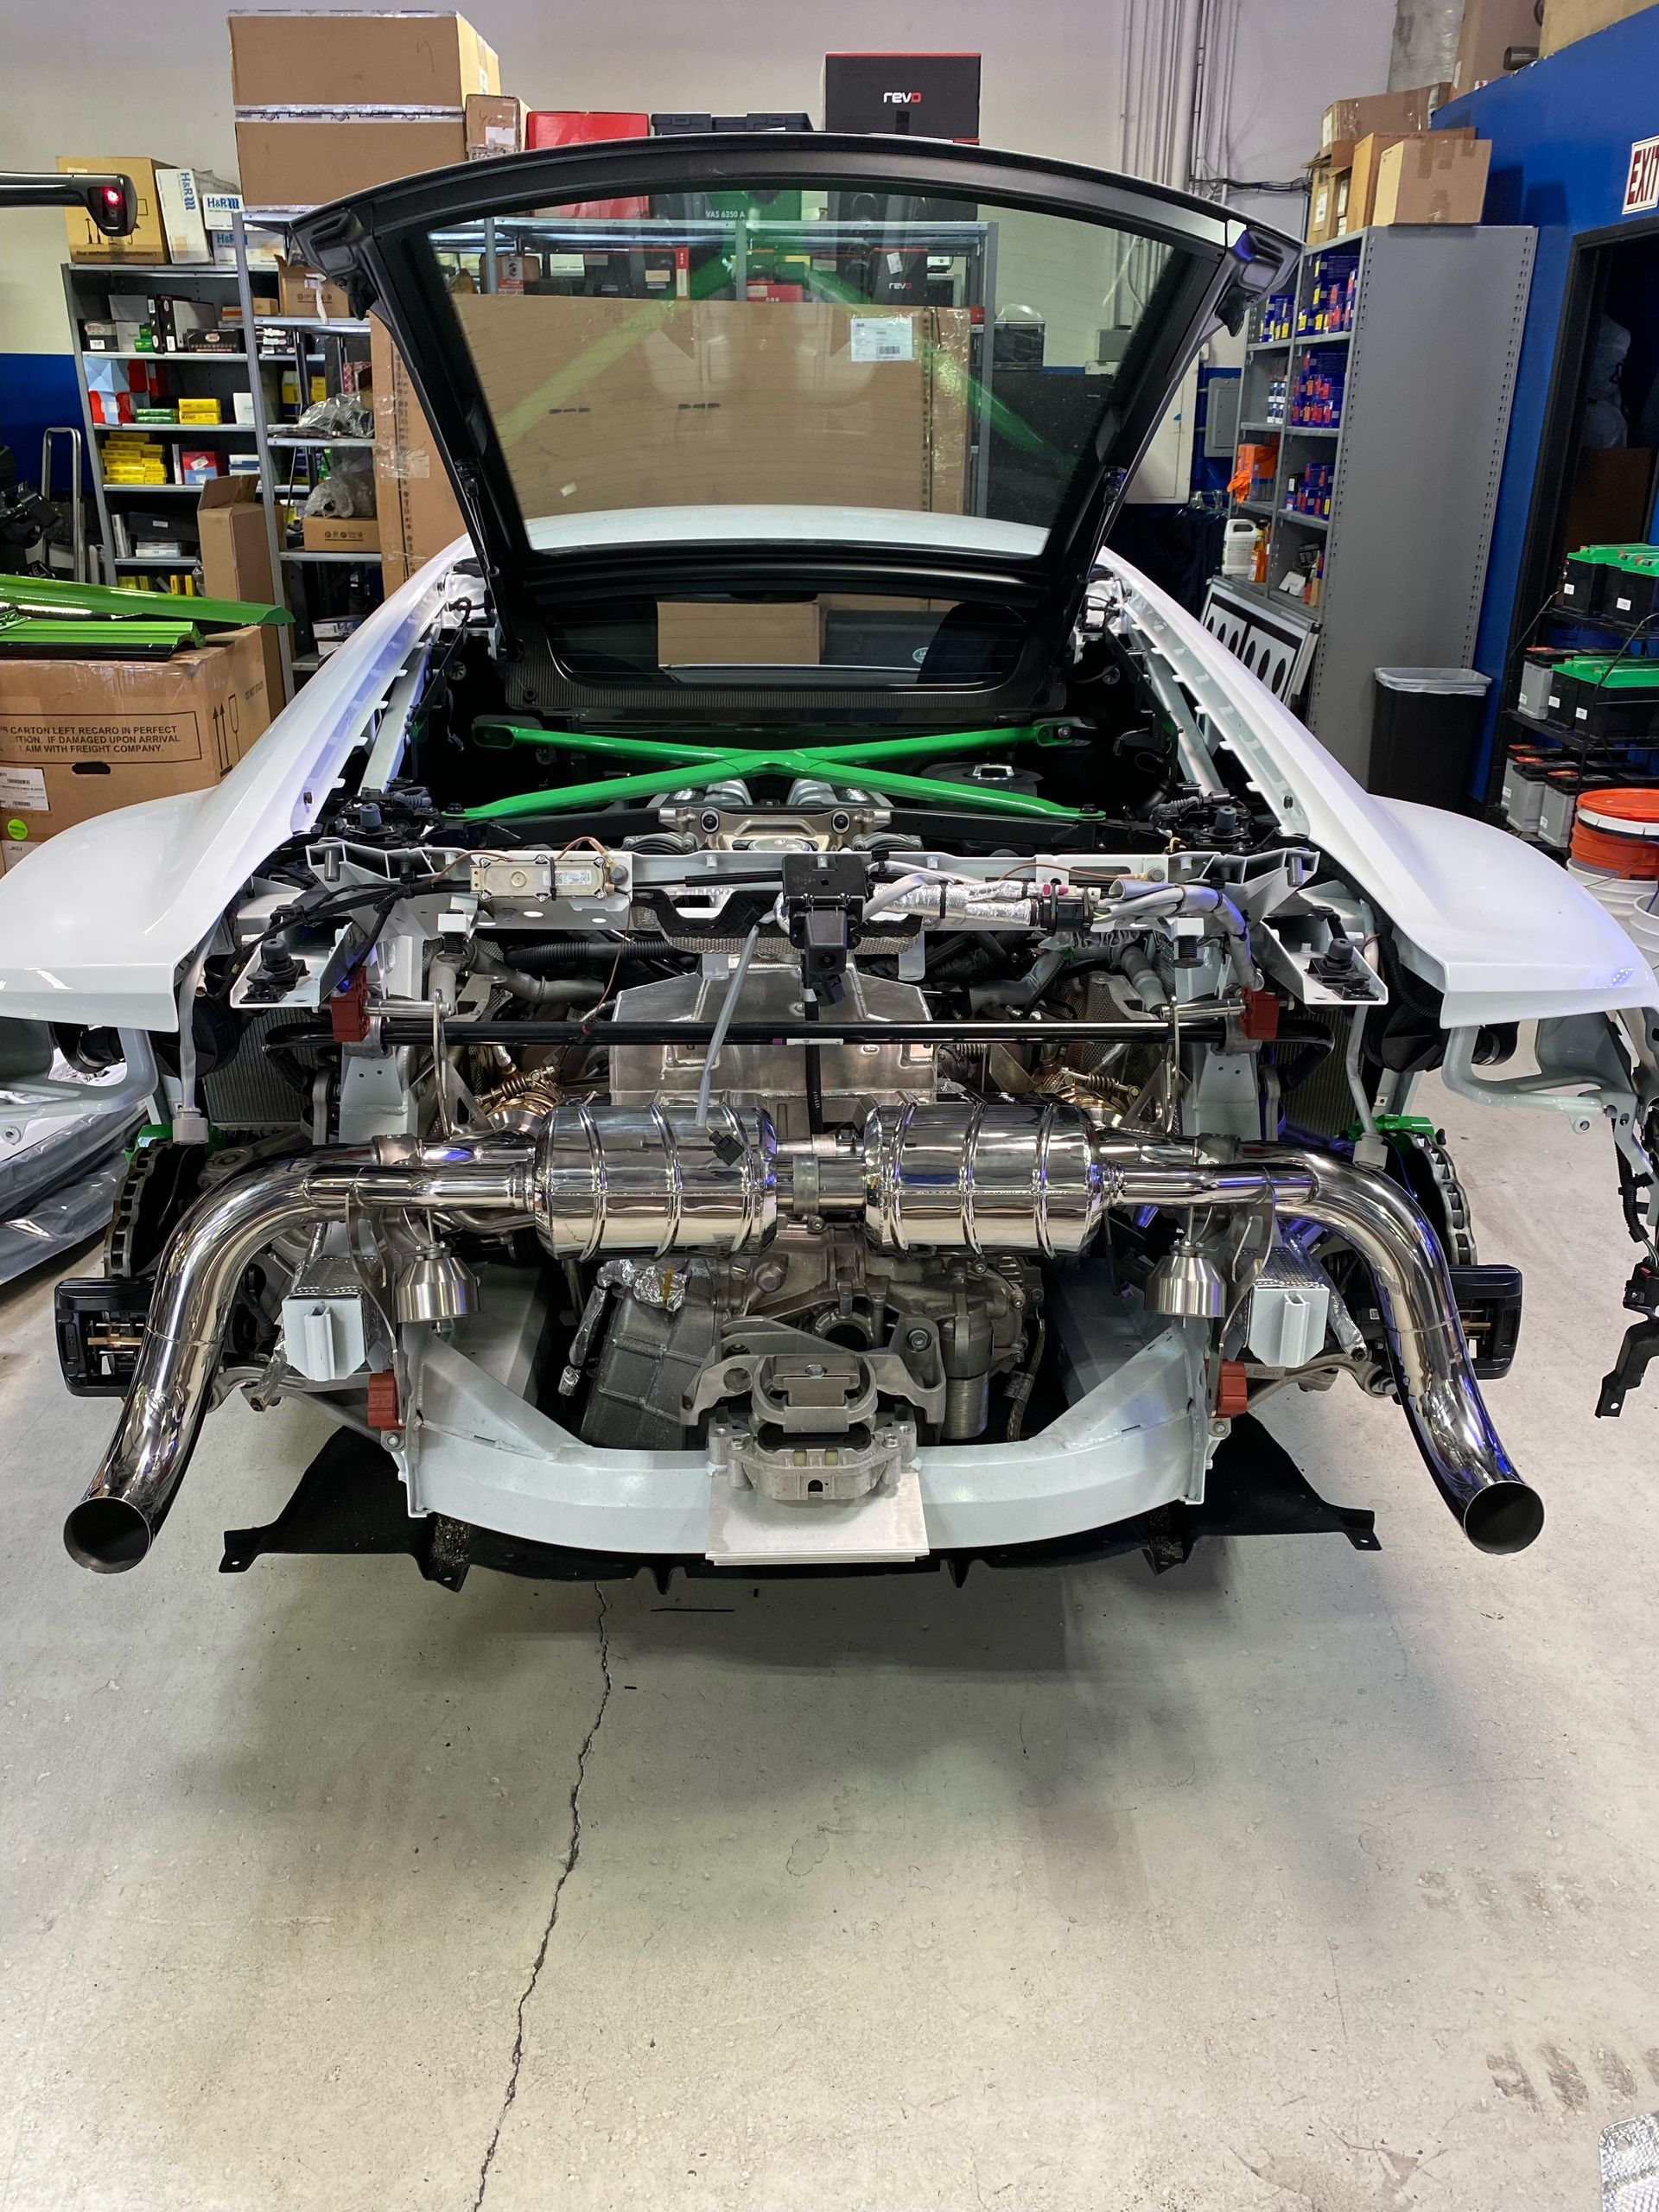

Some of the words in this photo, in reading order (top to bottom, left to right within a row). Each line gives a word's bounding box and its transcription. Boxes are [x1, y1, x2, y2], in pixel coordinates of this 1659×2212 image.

[883, 92, 923, 103] revo
[1627, 145, 1659, 205] EXIT
[181, 173, 194, 195] H&R
[207, 198, 227, 207] H&R
[139, 734, 180, 743] ARRIVAL
